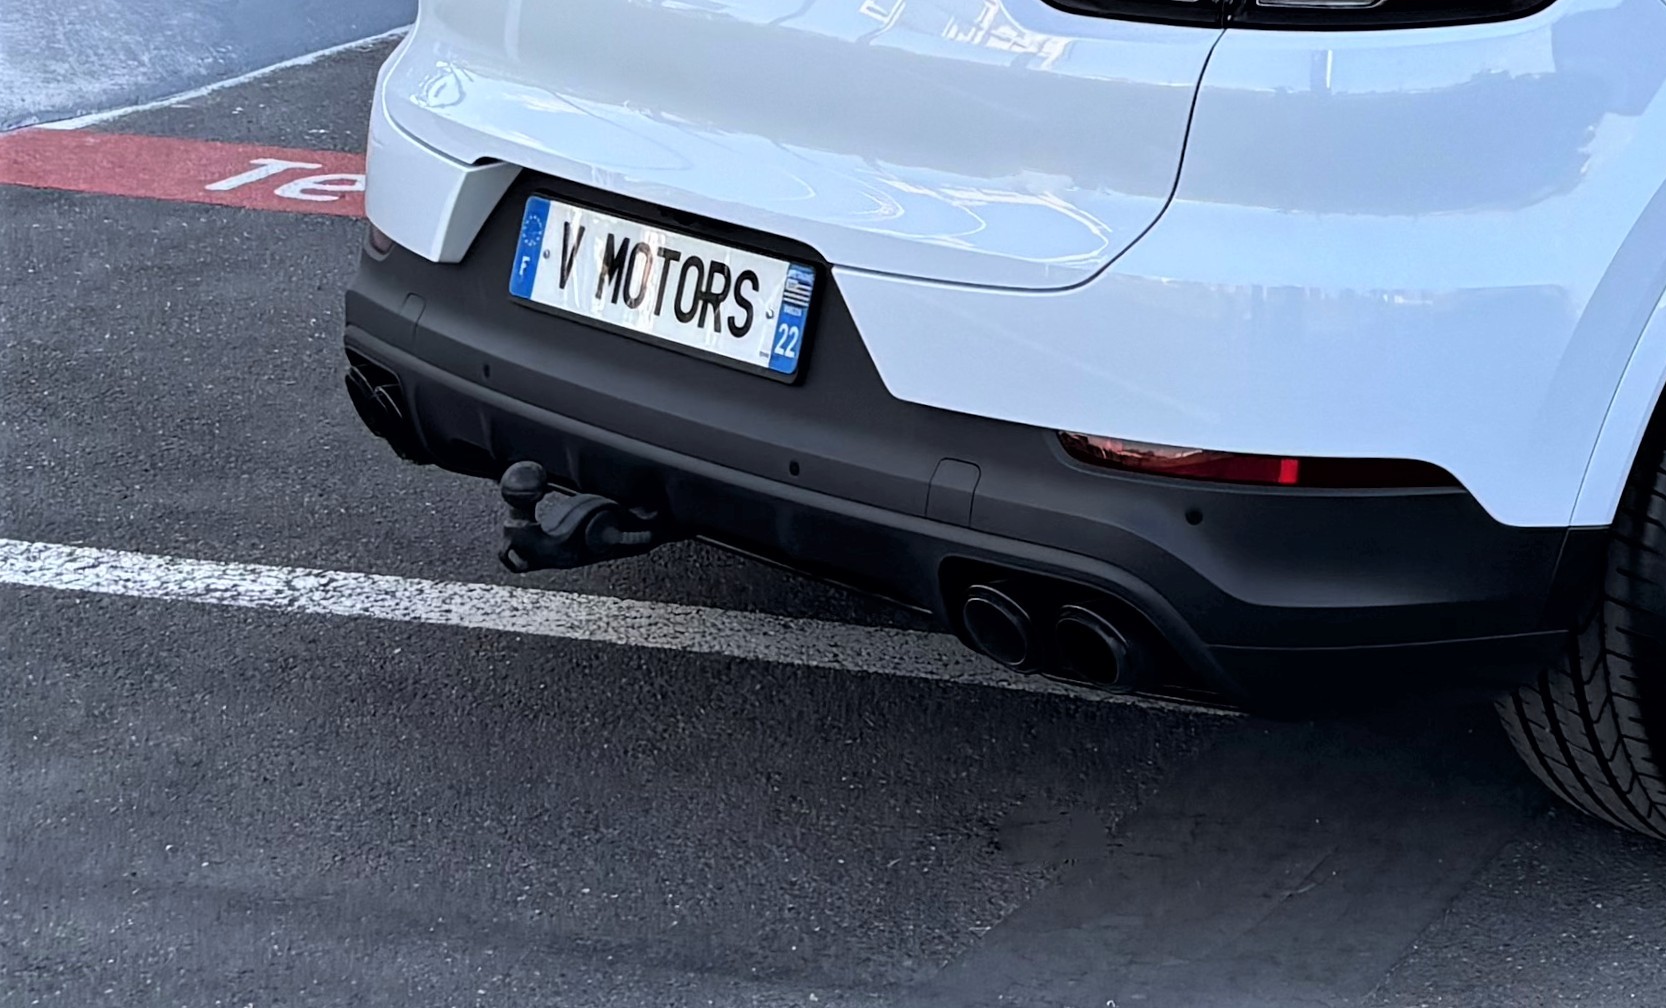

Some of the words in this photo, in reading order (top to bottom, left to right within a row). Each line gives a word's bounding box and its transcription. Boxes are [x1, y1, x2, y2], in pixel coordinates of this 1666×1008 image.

[205, 158, 366, 201] Te
[559, 221, 586, 290] V
[595, 233, 760, 339] MOTORS
[774, 323, 800, 359] 22
